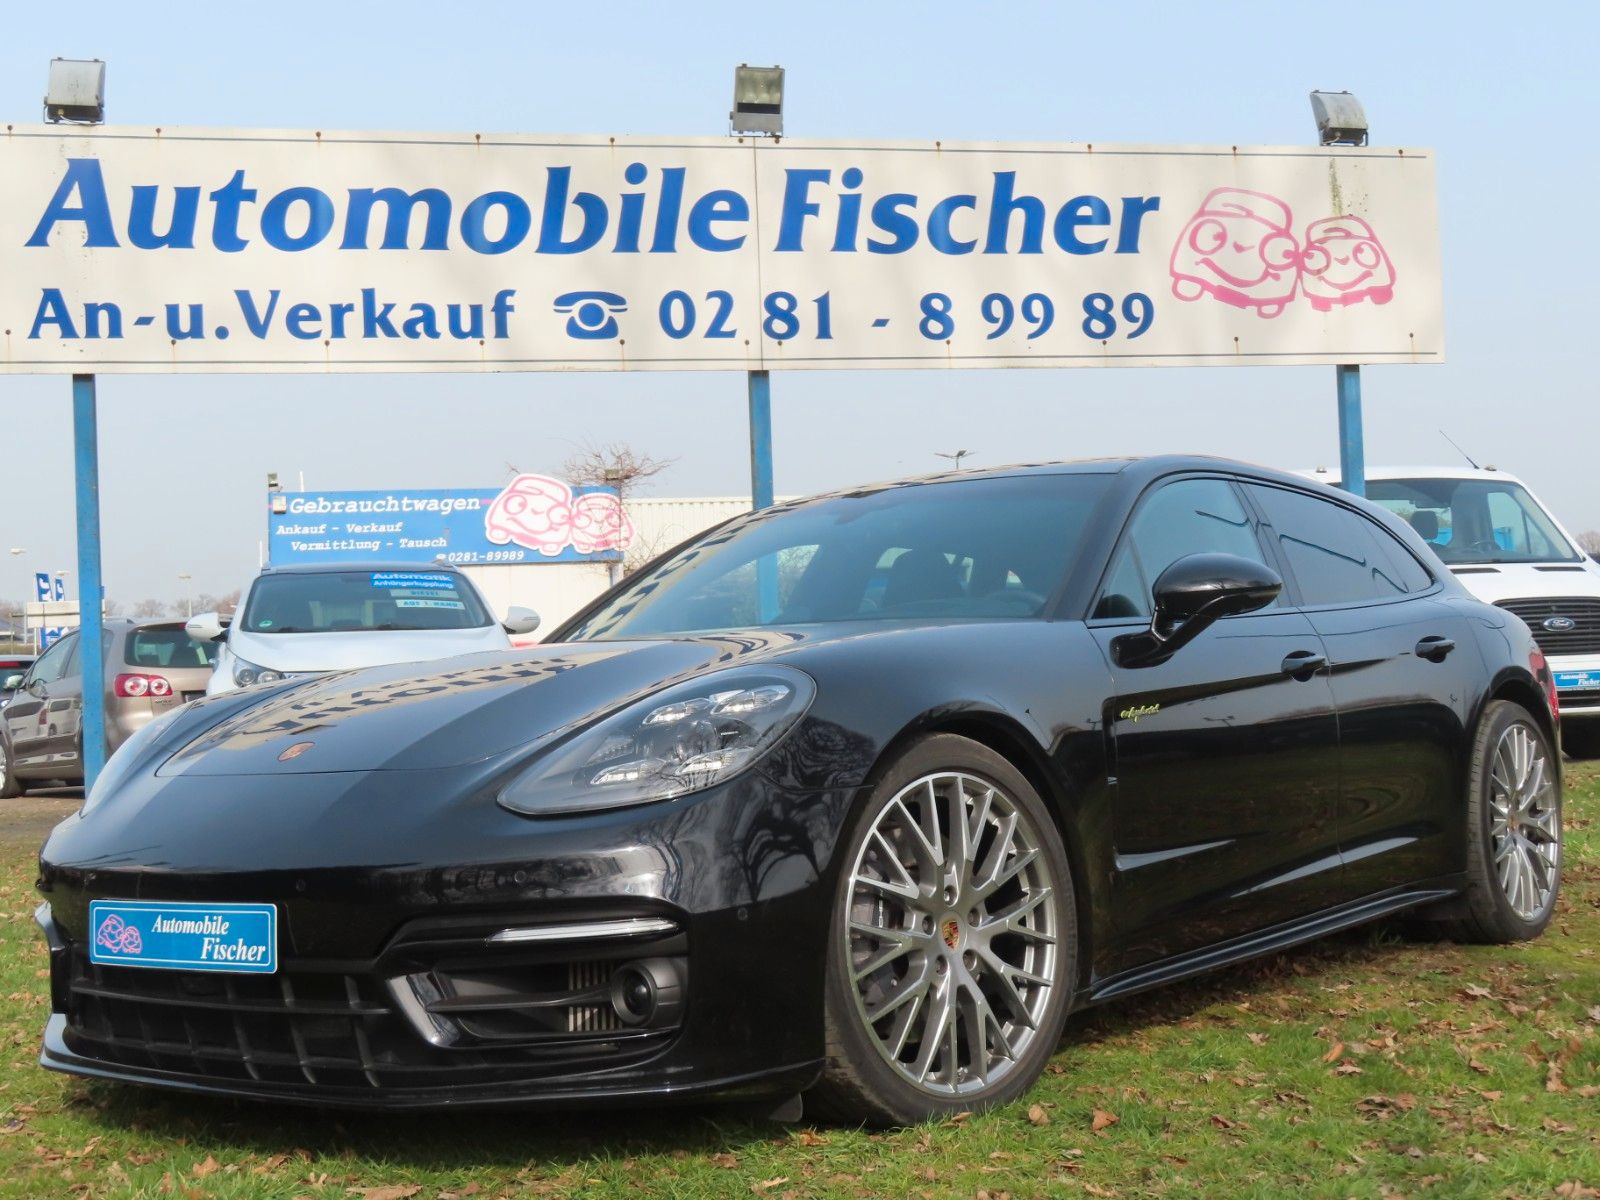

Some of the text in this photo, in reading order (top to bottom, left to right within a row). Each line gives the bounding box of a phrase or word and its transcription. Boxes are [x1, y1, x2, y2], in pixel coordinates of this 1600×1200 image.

[24, 157, 1161, 256] Automobile Fischer
[290, 494, 482, 516] Gebrauchtwagen
[276, 523, 328, 535] Ankauf
[346, 521, 404, 533] Verkauf
[290, 539, 382, 552] Vermittlung
[399, 537, 448, 549] Tausch
[447, 550, 525, 562] 0281-89989
[373, 573, 452, 582] Automatik
[151, 914, 230, 935] Automobile
[200, 937, 266, 962] Fischer
